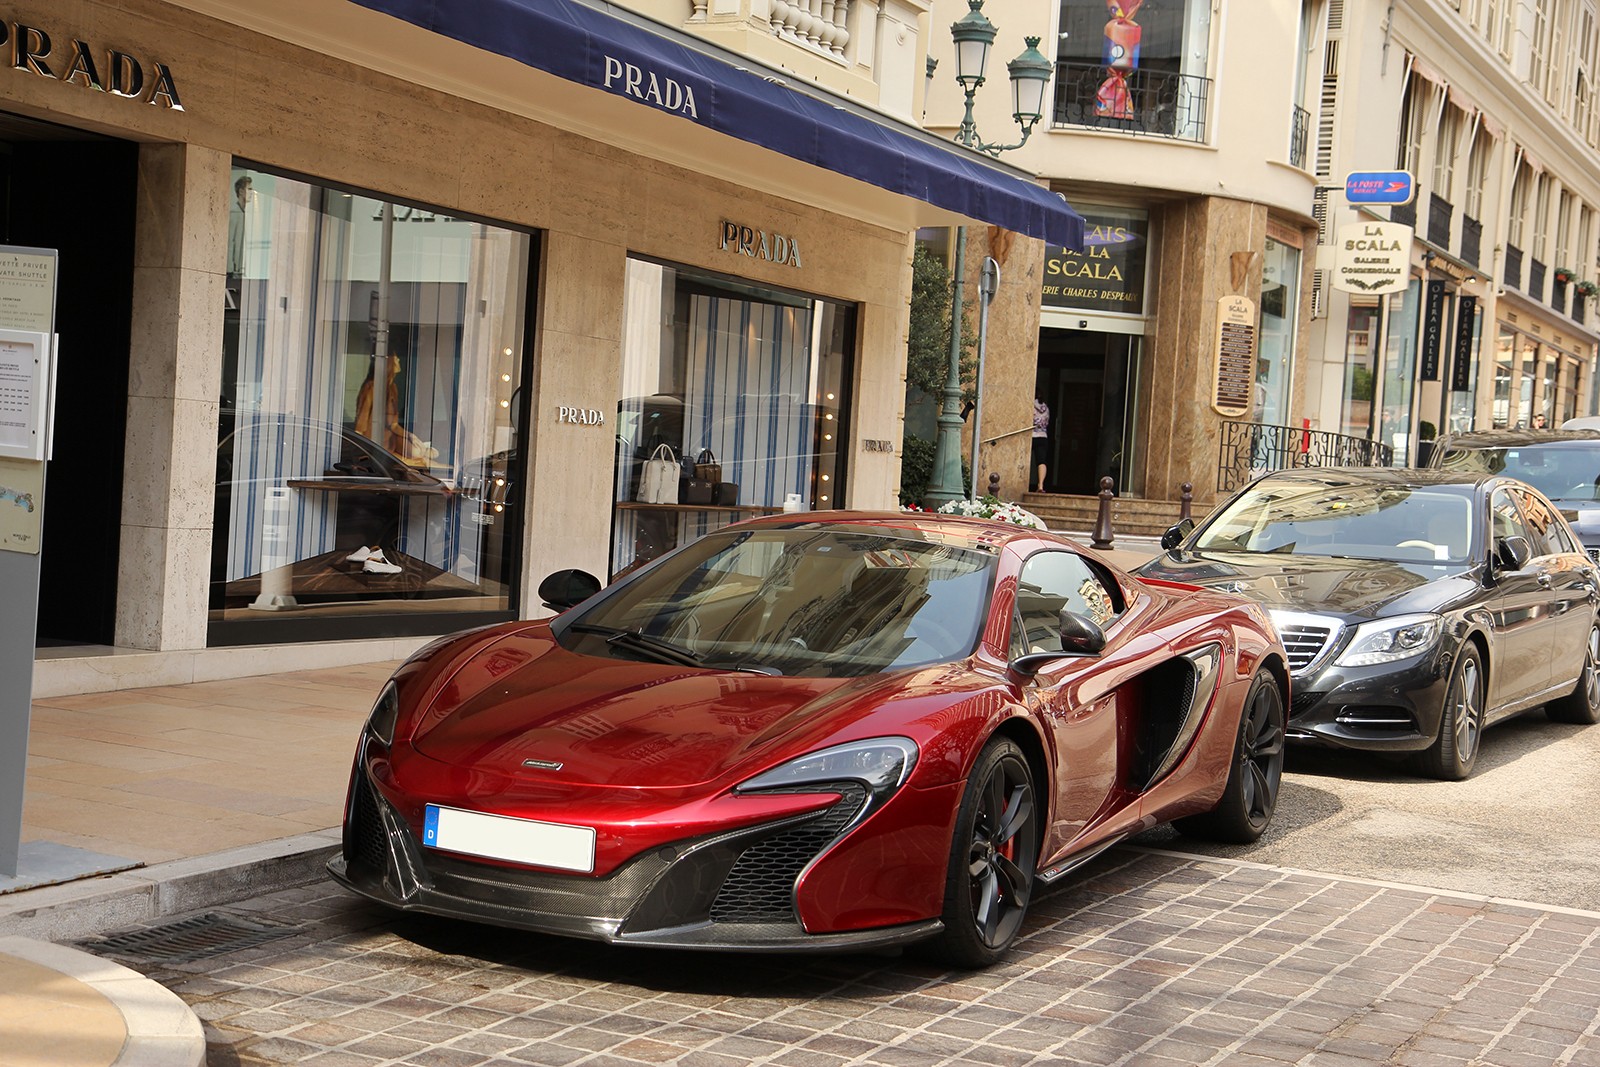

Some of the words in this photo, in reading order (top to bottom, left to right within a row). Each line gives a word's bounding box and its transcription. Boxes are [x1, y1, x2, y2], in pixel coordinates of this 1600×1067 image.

[0, 19, 185, 113] RADA
[603, 55, 698, 119] PRADA
[1360, 180, 1384, 189] POSTE
[1083, 225, 1127, 243] AIS
[1364, 226, 1383, 236] LA
[719, 220, 802, 268] PRADA
[1089, 245, 1110, 259] LA
[1345, 240, 1402, 251] SCALA
[1047, 259, 1123, 281] SCALA
[1063, 287, 1098, 299] CHARLES
[557, 406, 604, 426] PRADA
[428, 829, 435, 839] D
